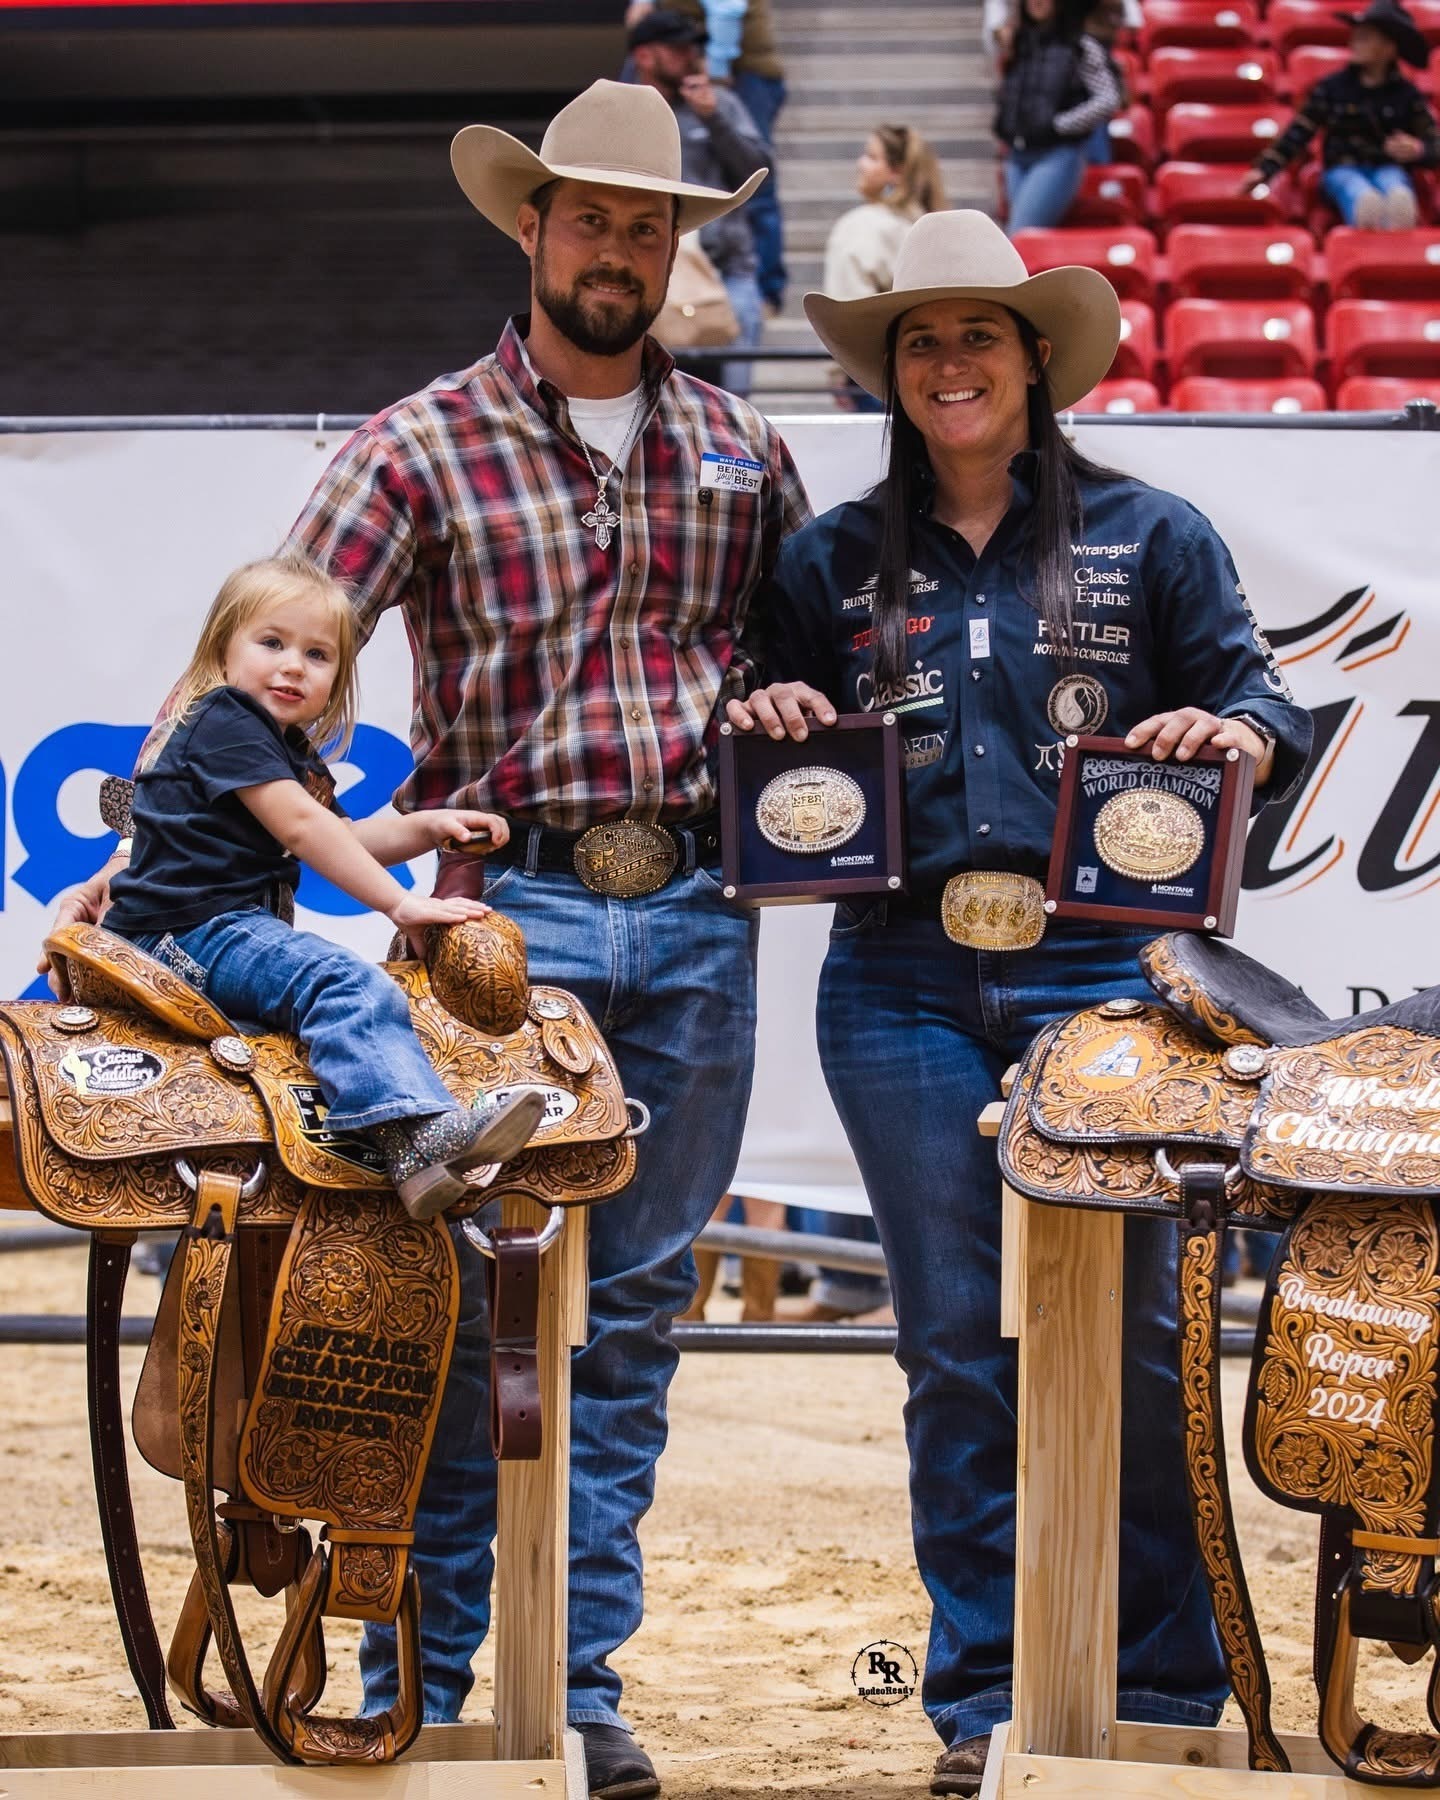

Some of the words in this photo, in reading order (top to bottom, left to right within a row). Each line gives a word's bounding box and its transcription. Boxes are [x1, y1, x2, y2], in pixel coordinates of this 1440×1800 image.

[717, 465, 748, 477] BEING
[734, 475, 759, 489] BEST
[1070, 542, 1140, 559] Wrangler
[1074, 567, 1130, 585] Classic
[909, 580, 940, 596] ORSE
[1074, 586, 1131, 608] Equine
[1079, 647, 1107, 662] COMES
[1107, 650, 1131, 665] CLOSE
[856, 659, 944, 713] Classic
[1083, 773, 1137, 798] WORLD
[1140, 772, 1216, 810] CHAMPION
[837, 854, 874, 864] MONTANA
[1157, 884, 1194, 894] MONTANA
[93, 1051, 144, 1069] Cactus
[89, 1065, 155, 1085] Saddlery
[1278, 1278, 1432, 1344] Breakaway
[294, 1326, 430, 1369] AVERAGE
[1305, 1333, 1397, 1385] Roper
[271, 1349, 438, 1396] CHAMPION
[265, 1373, 430, 1417] BREAKAWAY
[1307, 1387, 1387, 1431] 2024
[292, 1404, 395, 1439] ROPER
